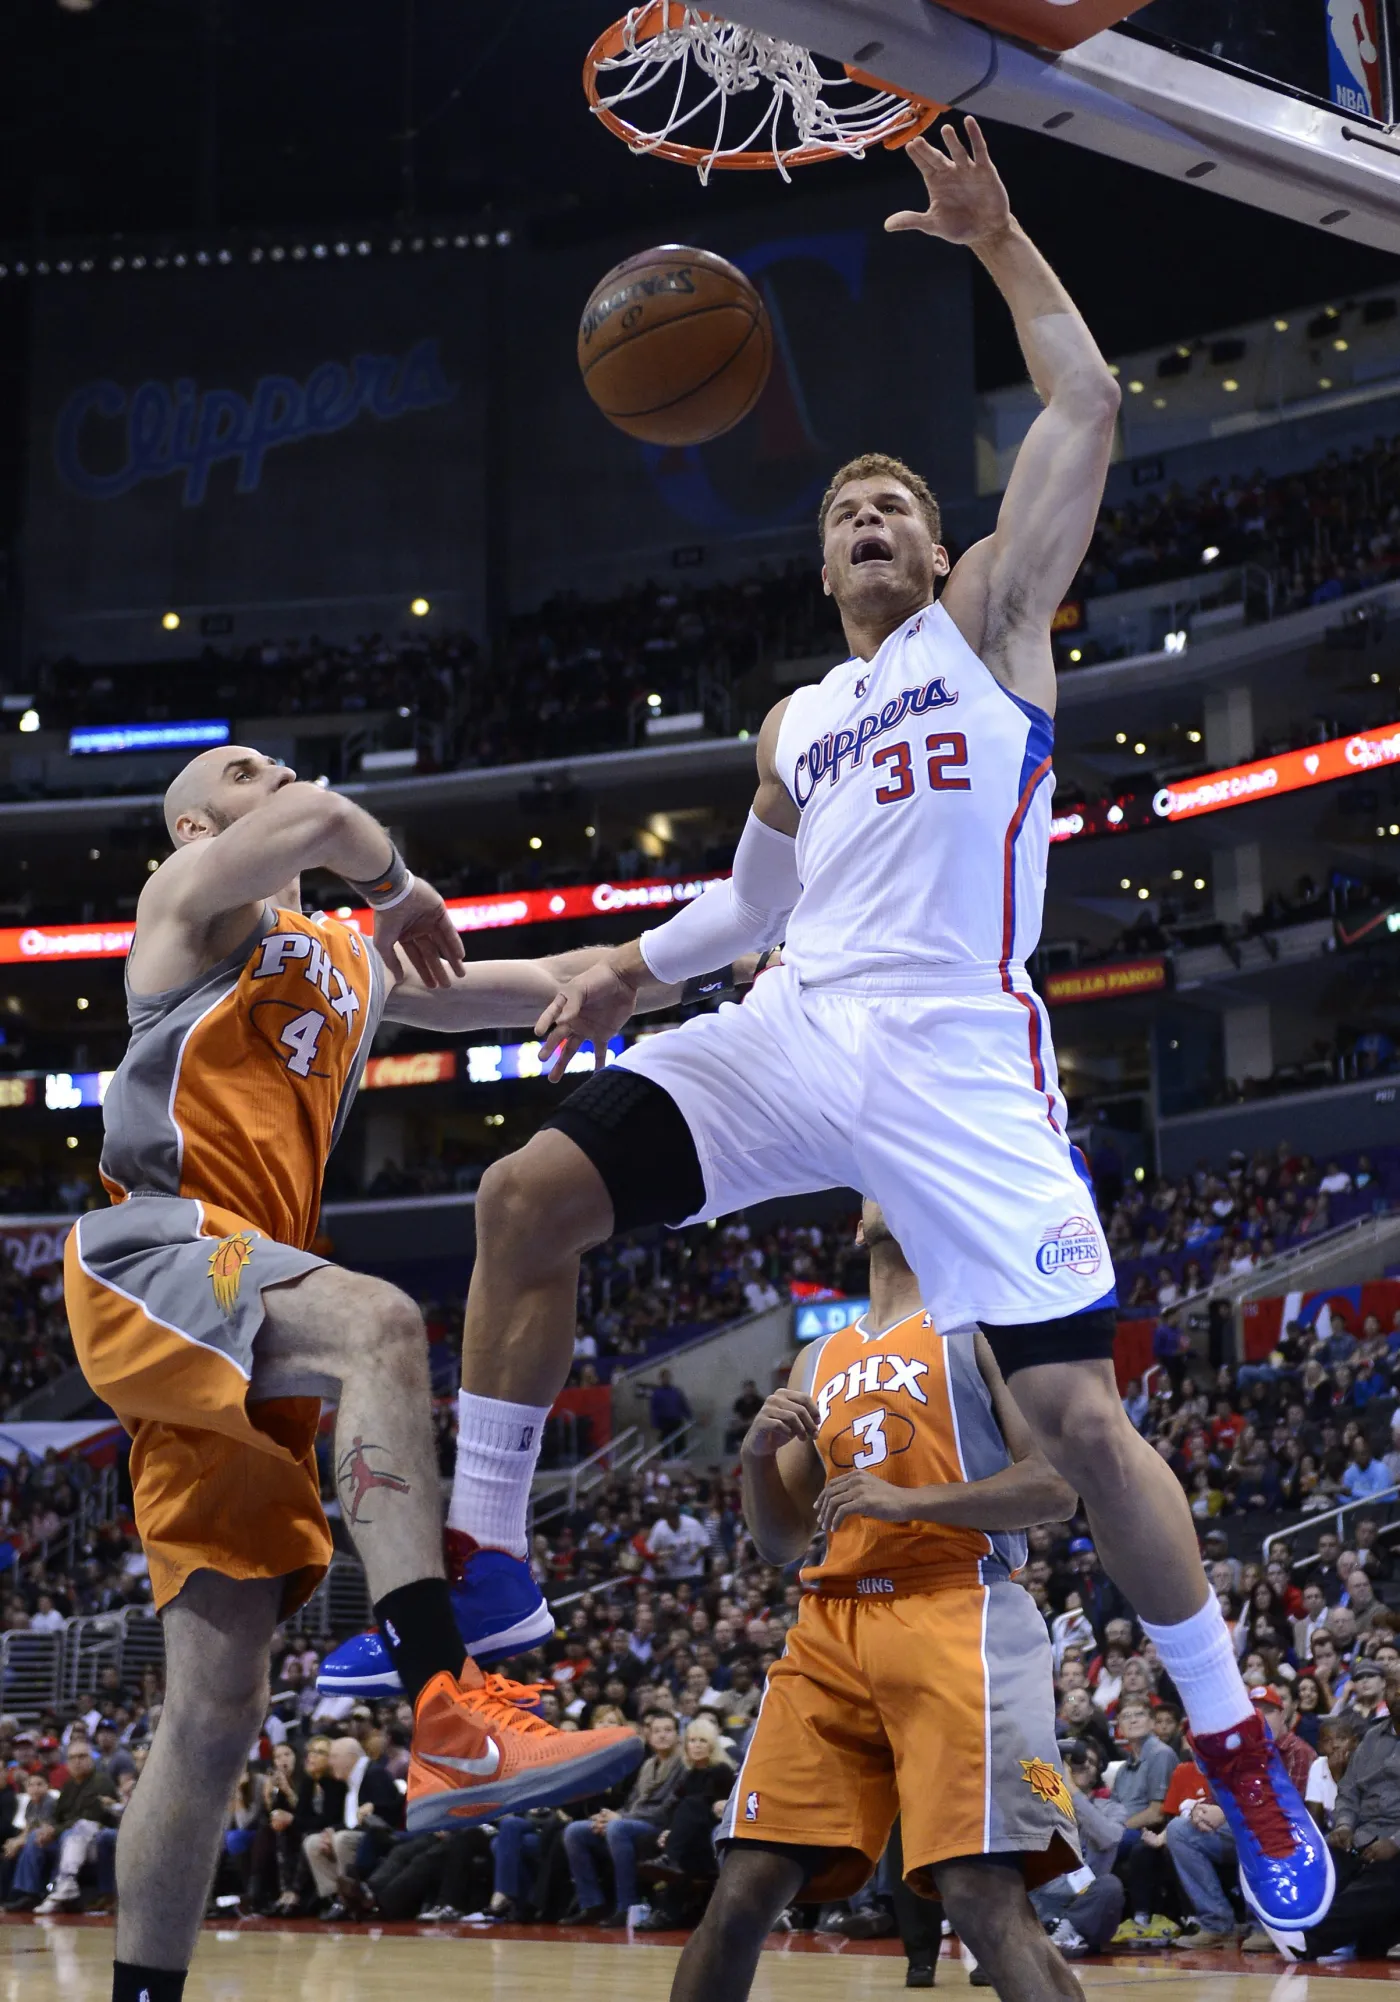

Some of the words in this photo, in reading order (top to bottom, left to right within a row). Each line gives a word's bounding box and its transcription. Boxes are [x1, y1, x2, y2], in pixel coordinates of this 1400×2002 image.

[1336, 84, 1368, 114] NBA
[54, 338, 459, 508] Clippers
[795, 676, 959, 812] Clippers
[872, 731, 971, 806] 32
[252, 932, 361, 1038] PHX
[280, 1009, 327, 1078] 4
[1036, 1241, 1099, 1275] CLIPPERS
[817, 1354, 929, 1432] PHX
[851, 1407, 888, 1470] 3
[856, 1578, 894, 1594] SUNS
